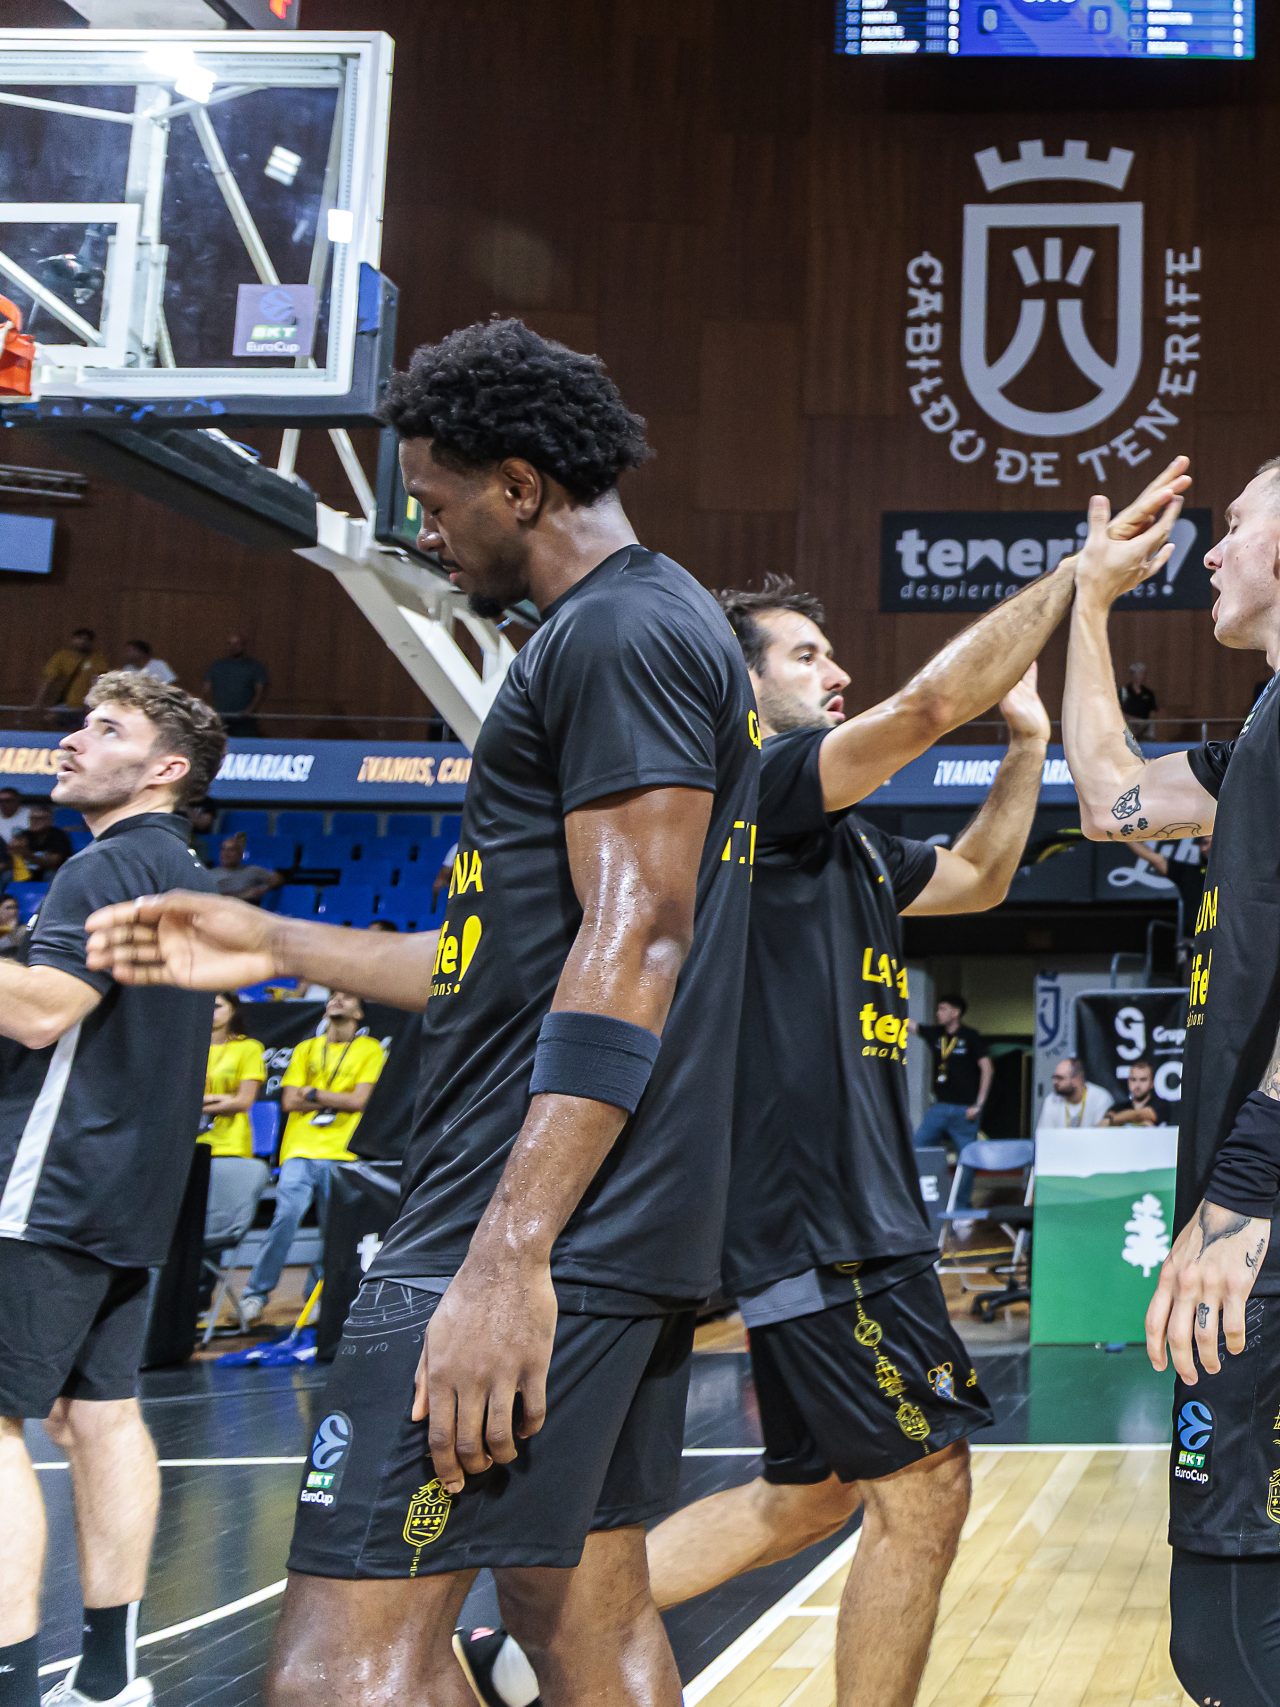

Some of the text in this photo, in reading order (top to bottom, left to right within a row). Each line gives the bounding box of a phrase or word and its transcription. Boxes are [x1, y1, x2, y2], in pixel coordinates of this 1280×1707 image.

[246, 341, 301, 354] EuroCup
[906, 246, 1201, 487] CABILDO DE TENERIFE
[216, 753, 315, 782] ANARIAS!
[1179, 1453, 1205, 1466] BKT
[1175, 1466, 1209, 1485] EuroCup
[301, 1490, 334, 1506] EuroCup
